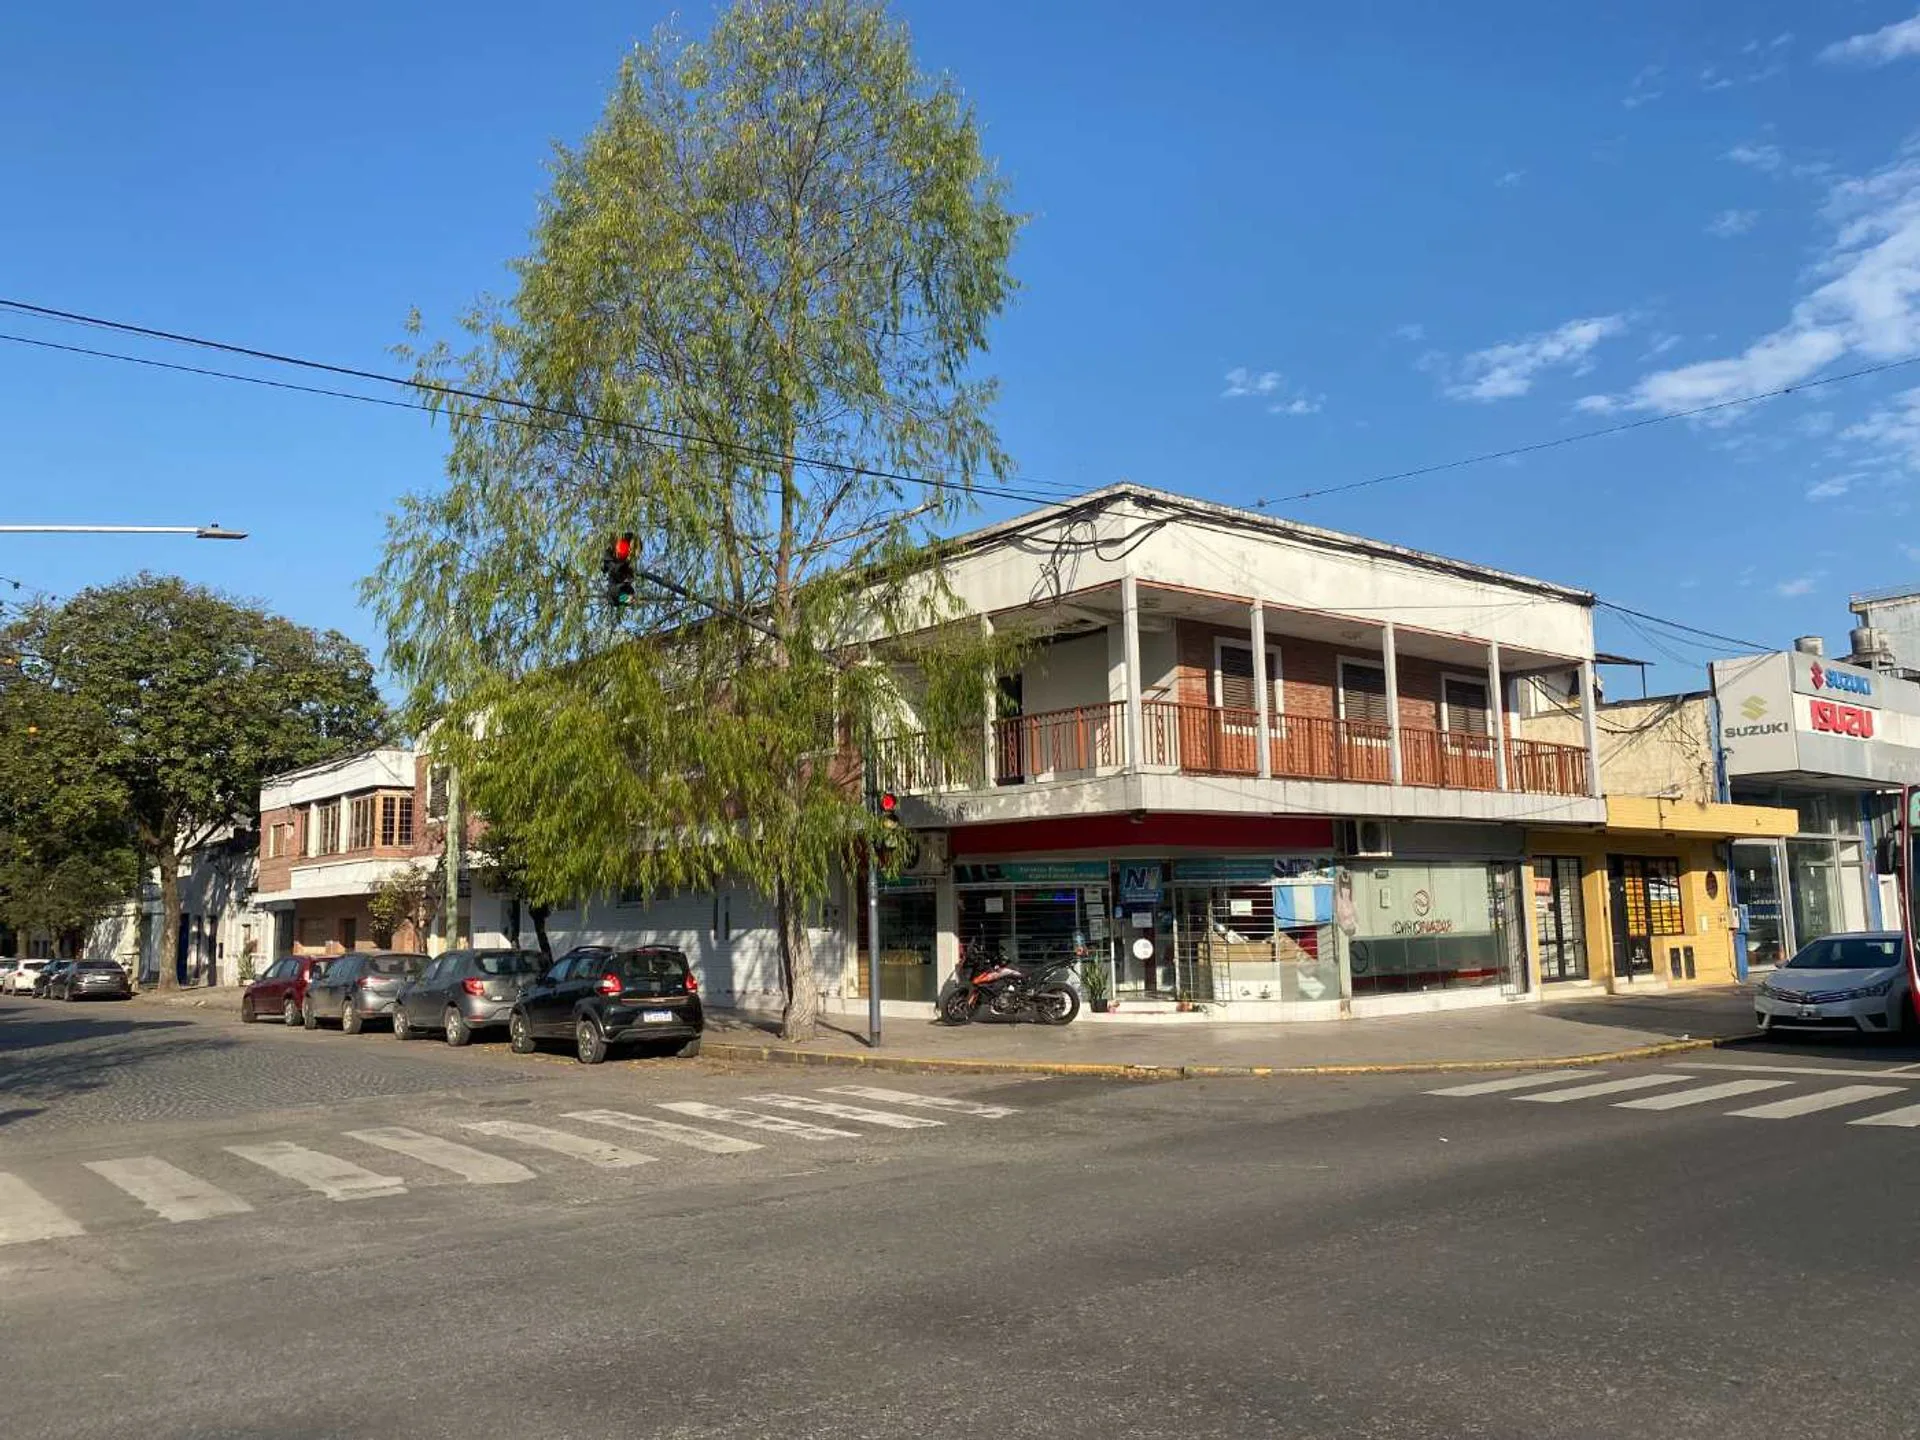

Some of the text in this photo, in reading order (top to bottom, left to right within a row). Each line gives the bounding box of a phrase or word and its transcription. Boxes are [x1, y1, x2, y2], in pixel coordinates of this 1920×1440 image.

[1826, 670, 1872, 695] SUZUKI
[1725, 723, 1788, 738] SUZUKI
[1810, 701, 1873, 738] ISUZU
